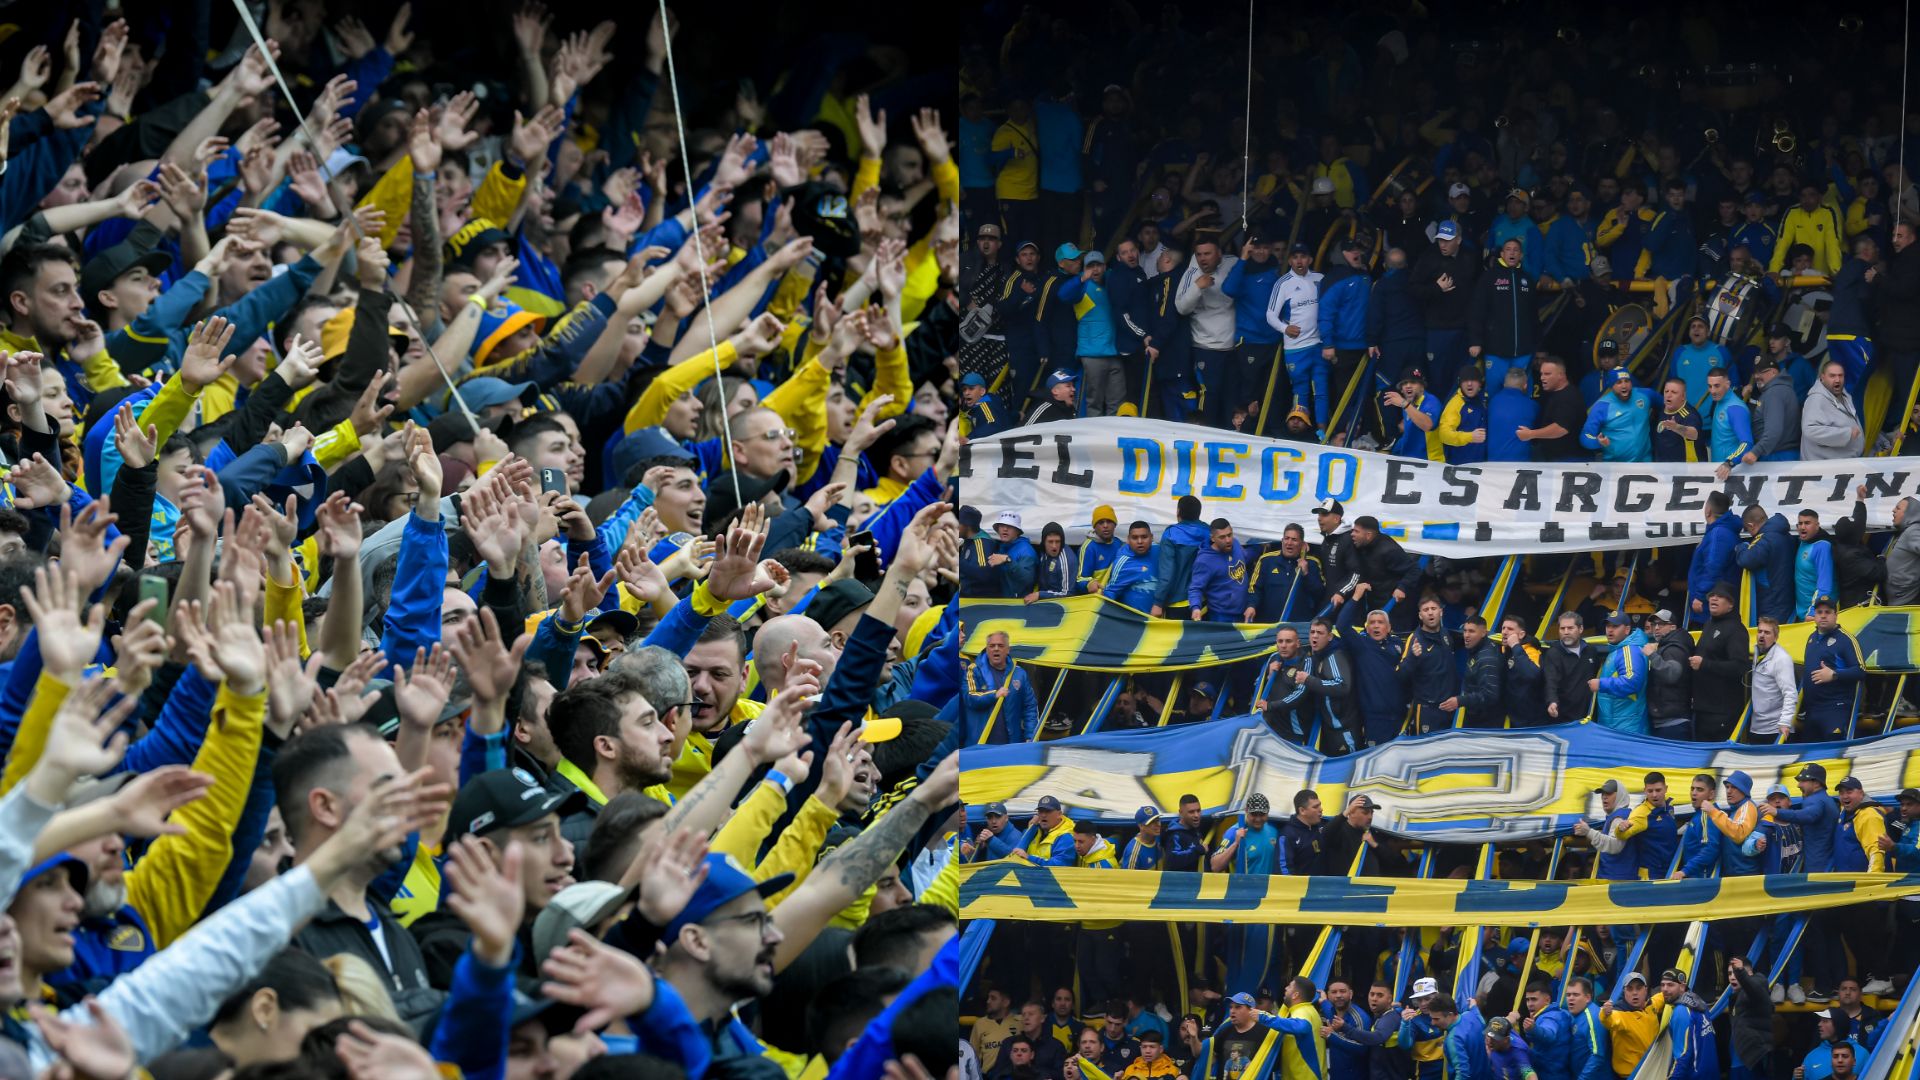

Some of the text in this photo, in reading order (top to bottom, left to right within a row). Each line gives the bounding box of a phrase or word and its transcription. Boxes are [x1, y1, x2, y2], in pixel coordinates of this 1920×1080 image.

[818, 194, 848, 218] 12
[998, 434, 1094, 489] EL
[1117, 436, 1363, 503] DIEGO
[1381, 459, 1483, 507] ES
[1503, 471, 1920, 513] ARGENTIN
[1225, 719, 1570, 843] 12
